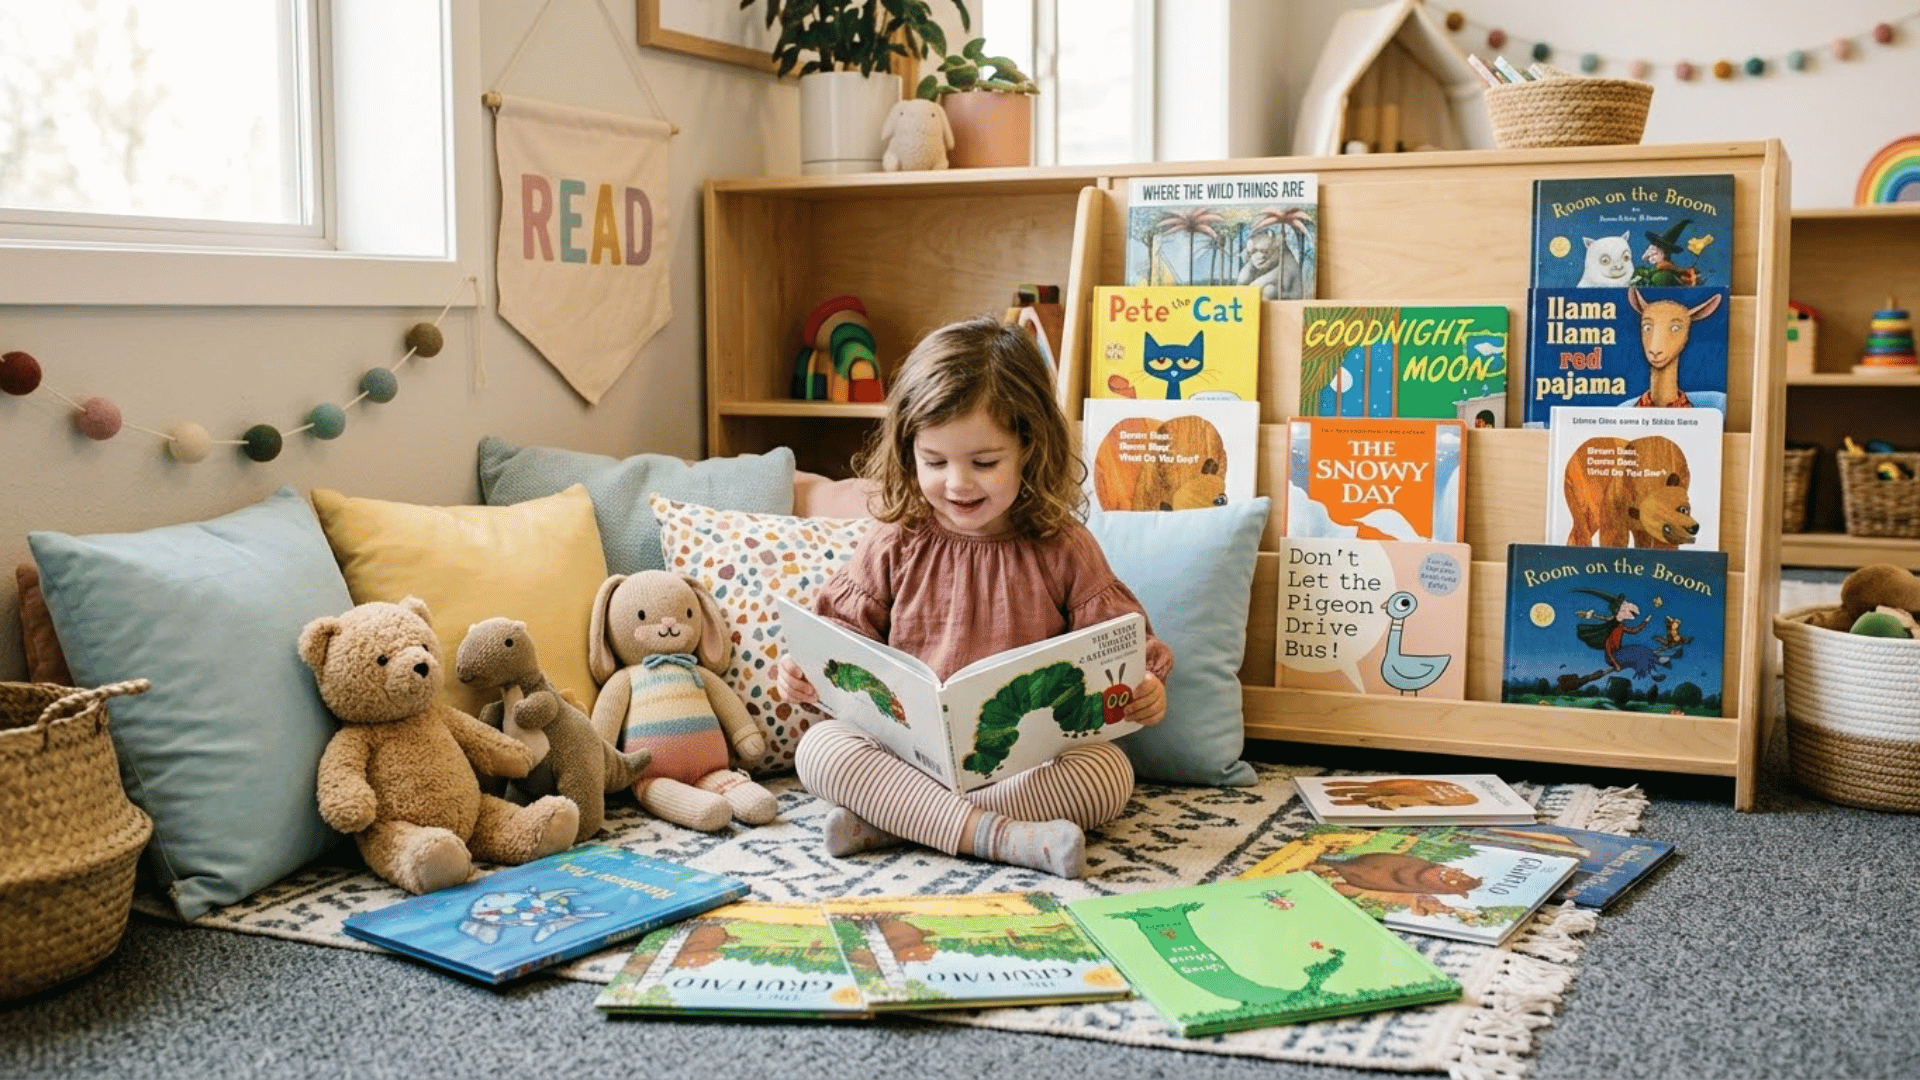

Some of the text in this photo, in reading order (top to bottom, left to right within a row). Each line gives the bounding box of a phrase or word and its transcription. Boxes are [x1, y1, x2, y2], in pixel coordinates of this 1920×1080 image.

[1143, 181, 1305, 201] WHERE THE WILD THINGS ARE
[1552, 196, 1601, 218] Room
[1605, 190, 1626, 203] on
[1631, 187, 1658, 202] the
[1665, 188, 1717, 216] Broom
[521, 173, 653, 266] READ
[1109, 295, 1170, 322] Pete
[1193, 296, 1243, 322] Cat
[1547, 296, 1617, 319] llama
[1305, 319, 1475, 346] GOODNIGHT
[1546, 322, 1616, 344] llama
[1403, 355, 1494, 382] MOON
[1559, 347, 1602, 369] red
[1536, 371, 1626, 400] pajama
[1348, 440, 1397, 456] THE
[1316, 459, 1429, 482] SNOWY
[1342, 484, 1402, 505] DAY
[1289, 548, 1359, 567] Don't
[1288, 571, 1381, 591] Let the
[1524, 558, 1712, 596] Room on the Broom
[1287, 593, 1374, 616] Pigeon
[1285, 617, 1358, 636] Drive
[1285, 640, 1338, 658] Bus!
